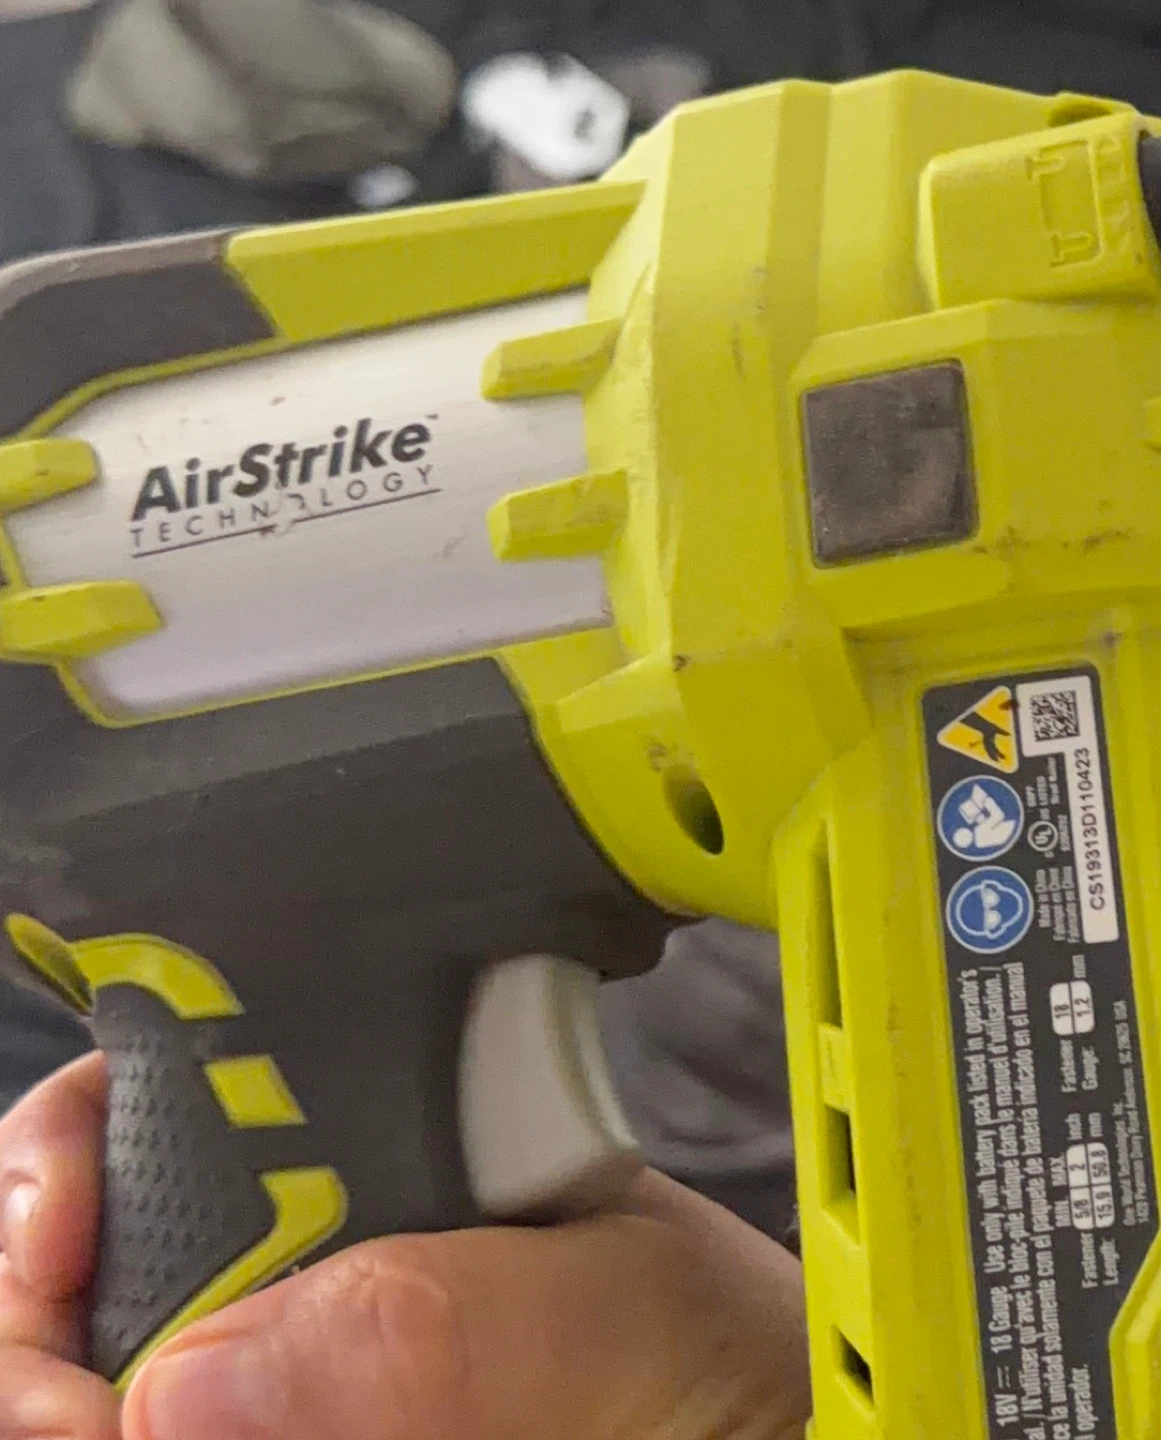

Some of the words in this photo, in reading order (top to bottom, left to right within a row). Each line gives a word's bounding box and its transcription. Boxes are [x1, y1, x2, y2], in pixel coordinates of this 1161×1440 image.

[1075, 748, 1105, 910] CS19313D110423
[958, 969, 985, 1033] operator's
[1004, 962, 1027, 1011] manual
[984, 974, 1007, 1053] d'utilisation.
[1008, 1014, 1028, 1027] el
[1054, 1004, 1070, 1018] 18
[1075, 998, 1090, 1017] 1.2
[965, 1037, 984, 1051] in
[1014, 1029, 1030, 1046] en
[966, 1054, 987, 1091] listed
[990, 1056, 1012, 1106] manuel
[1013, 1048, 1036, 1104] indicado
[970, 1094, 994, 1126] pack
[998, 1124, 1017, 1156] dans
[1018, 1108, 1041, 1154] batería
[975, 1130, 996, 1176] battery
[1023, 1158, 1043, 1174] de
[978, 1179, 998, 1209] with
[1000, 1159, 1024, 1209] indiqué
[1026, 1177, 1053, 1232] paquete
[980, 1212, 1004, 1241] only
[1006, 1212, 1030, 1272] bloc-pile
[1030, 1234, 1051, 1247] el
[984, 1245, 1004, 1272] Use
[1036, 1251, 1054, 1275] con
[988, 1286, 1012, 1331] Gauge
[1015, 1290, 1038, 1344] qu'avec
[1036, 1279, 1061, 1352] solamente
[990, 1334, 1012, 1353] 18
[1020, 1347, 1041, 1410] N'utiliser
[1042, 1354, 1066, 1402] unidad
[1070, 1364, 1098, 1431] operador.
[994, 1394, 1018, 1425] 18V
[1048, 1406, 1068, 1420] la
